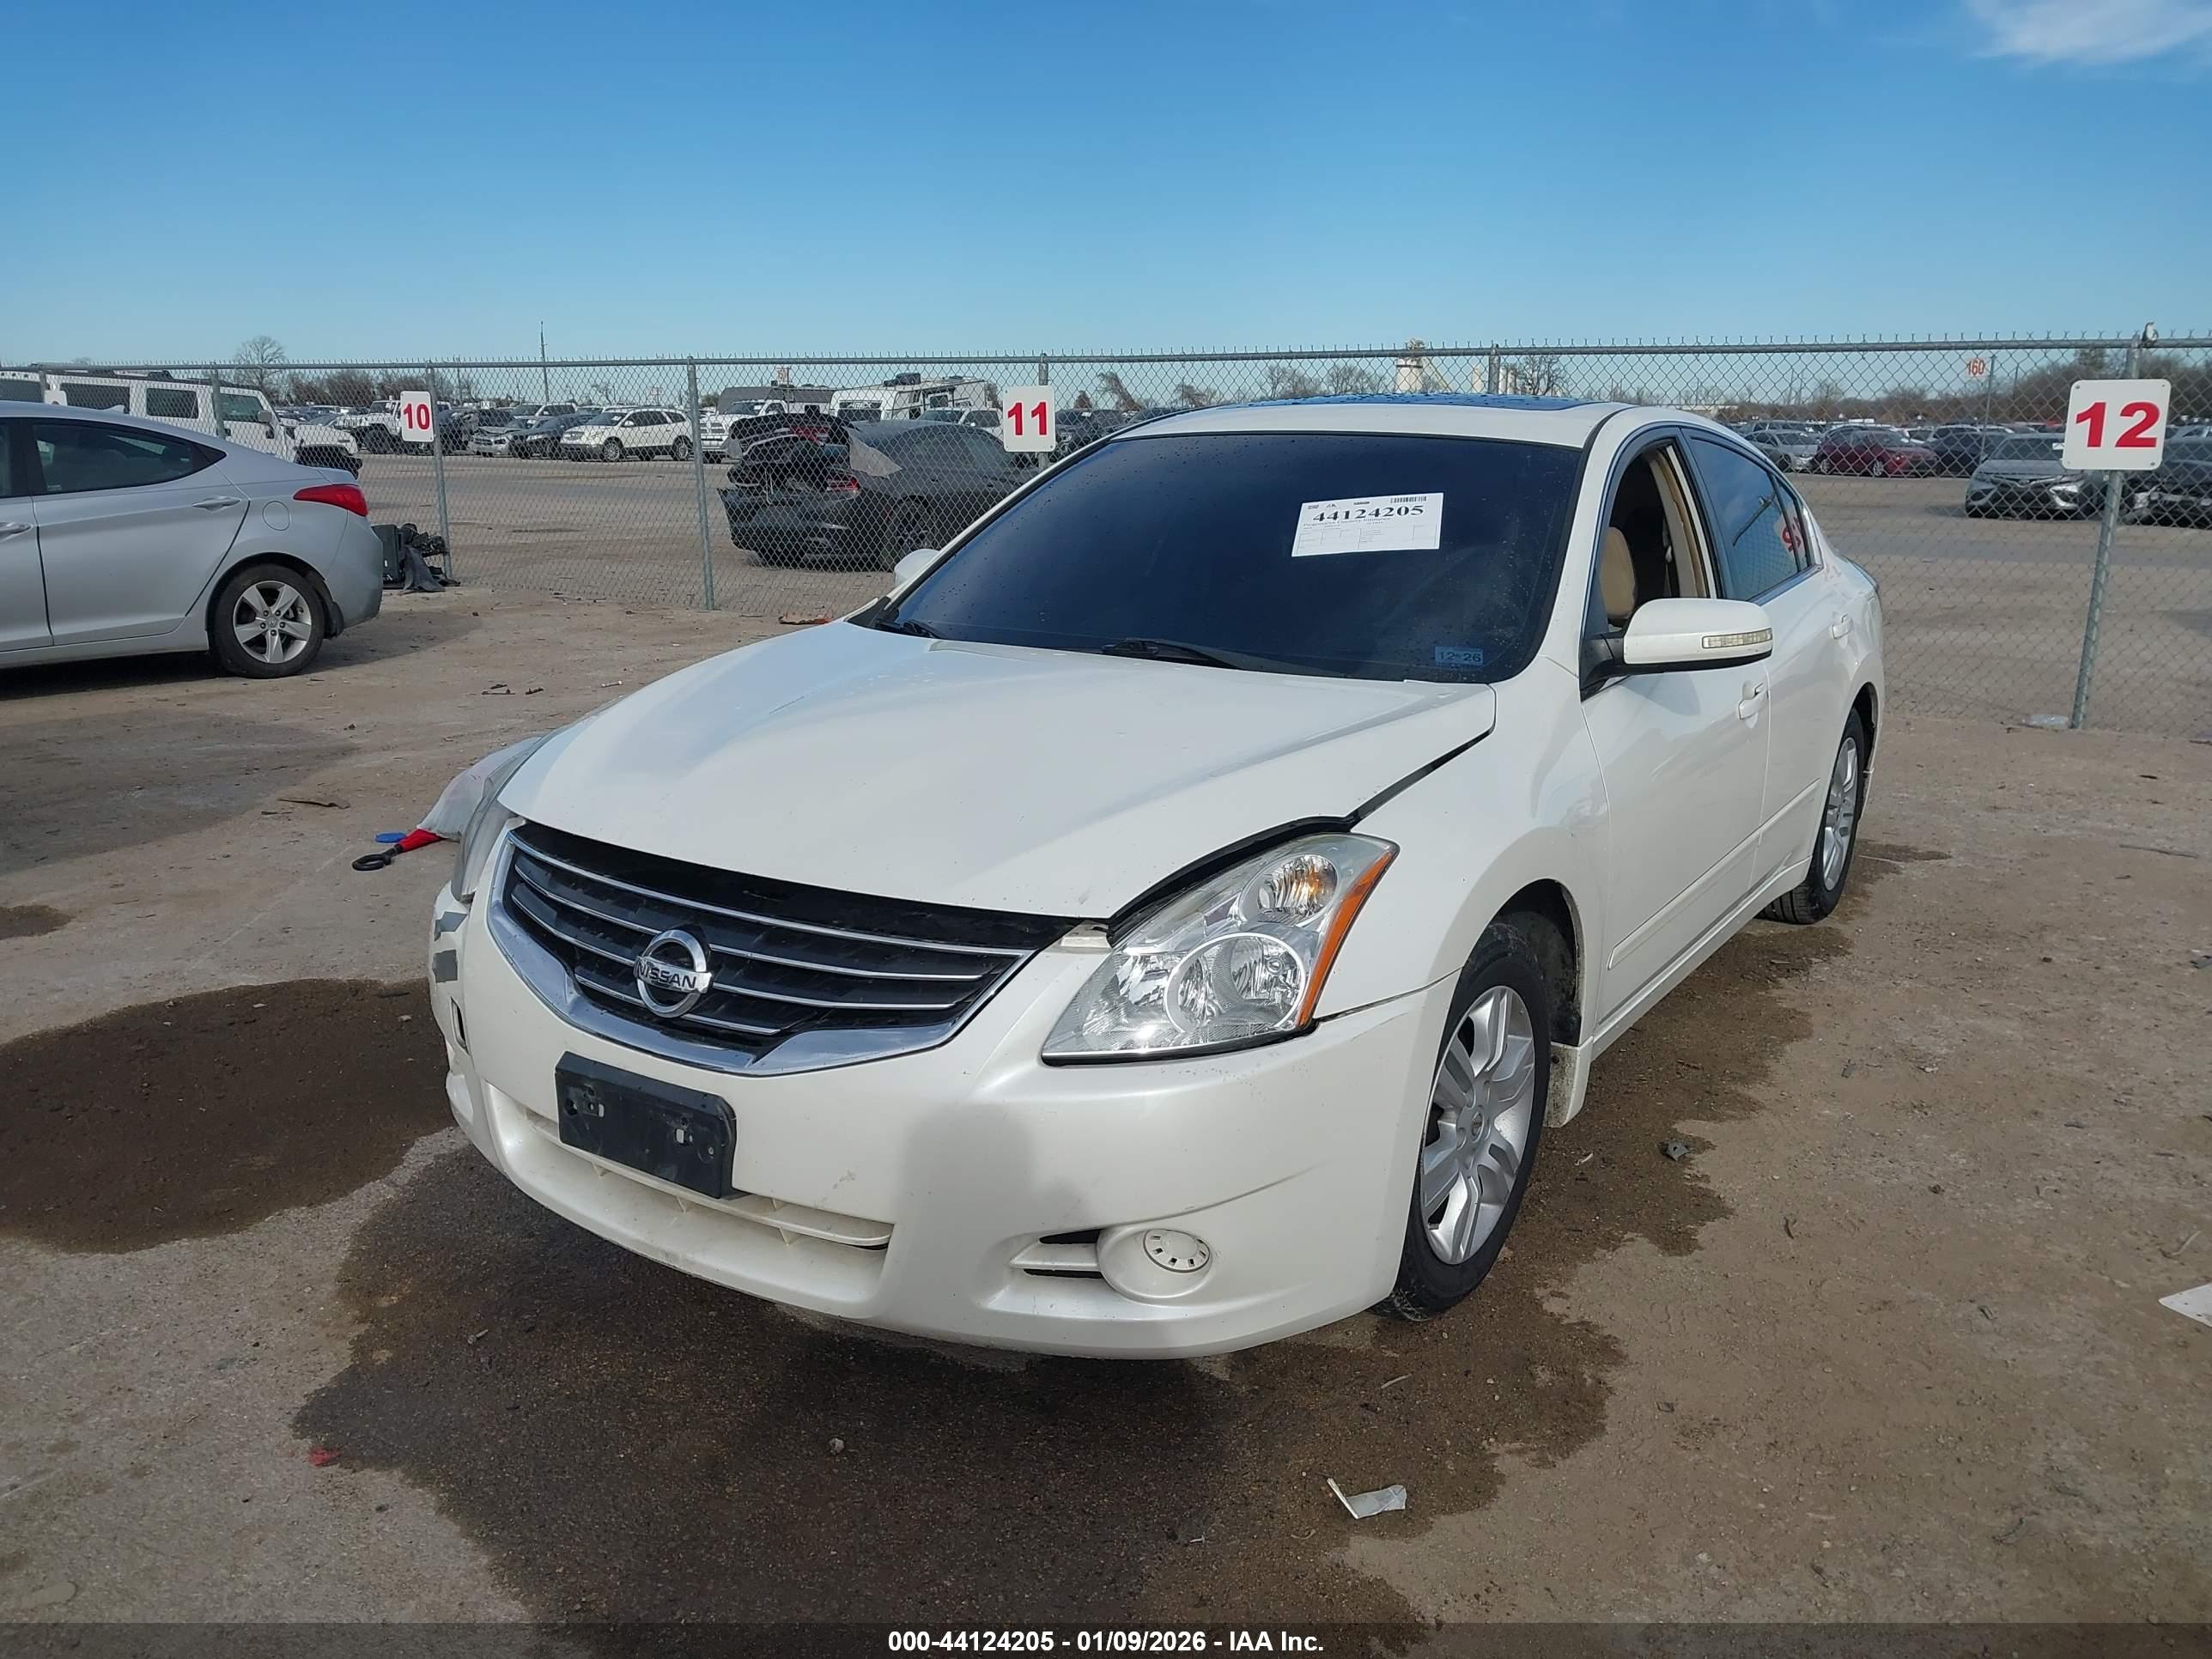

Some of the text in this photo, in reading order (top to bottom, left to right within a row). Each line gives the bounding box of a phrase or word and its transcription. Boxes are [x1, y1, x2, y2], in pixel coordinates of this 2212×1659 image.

[1966, 359, 1984, 375] 160
[404, 404, 430, 430] 10
[1007, 401, 1048, 436] 11
[2075, 402, 2160, 448] 12
[1313, 504, 1425, 522] 44124205
[636, 959, 697, 989] NISSAN
